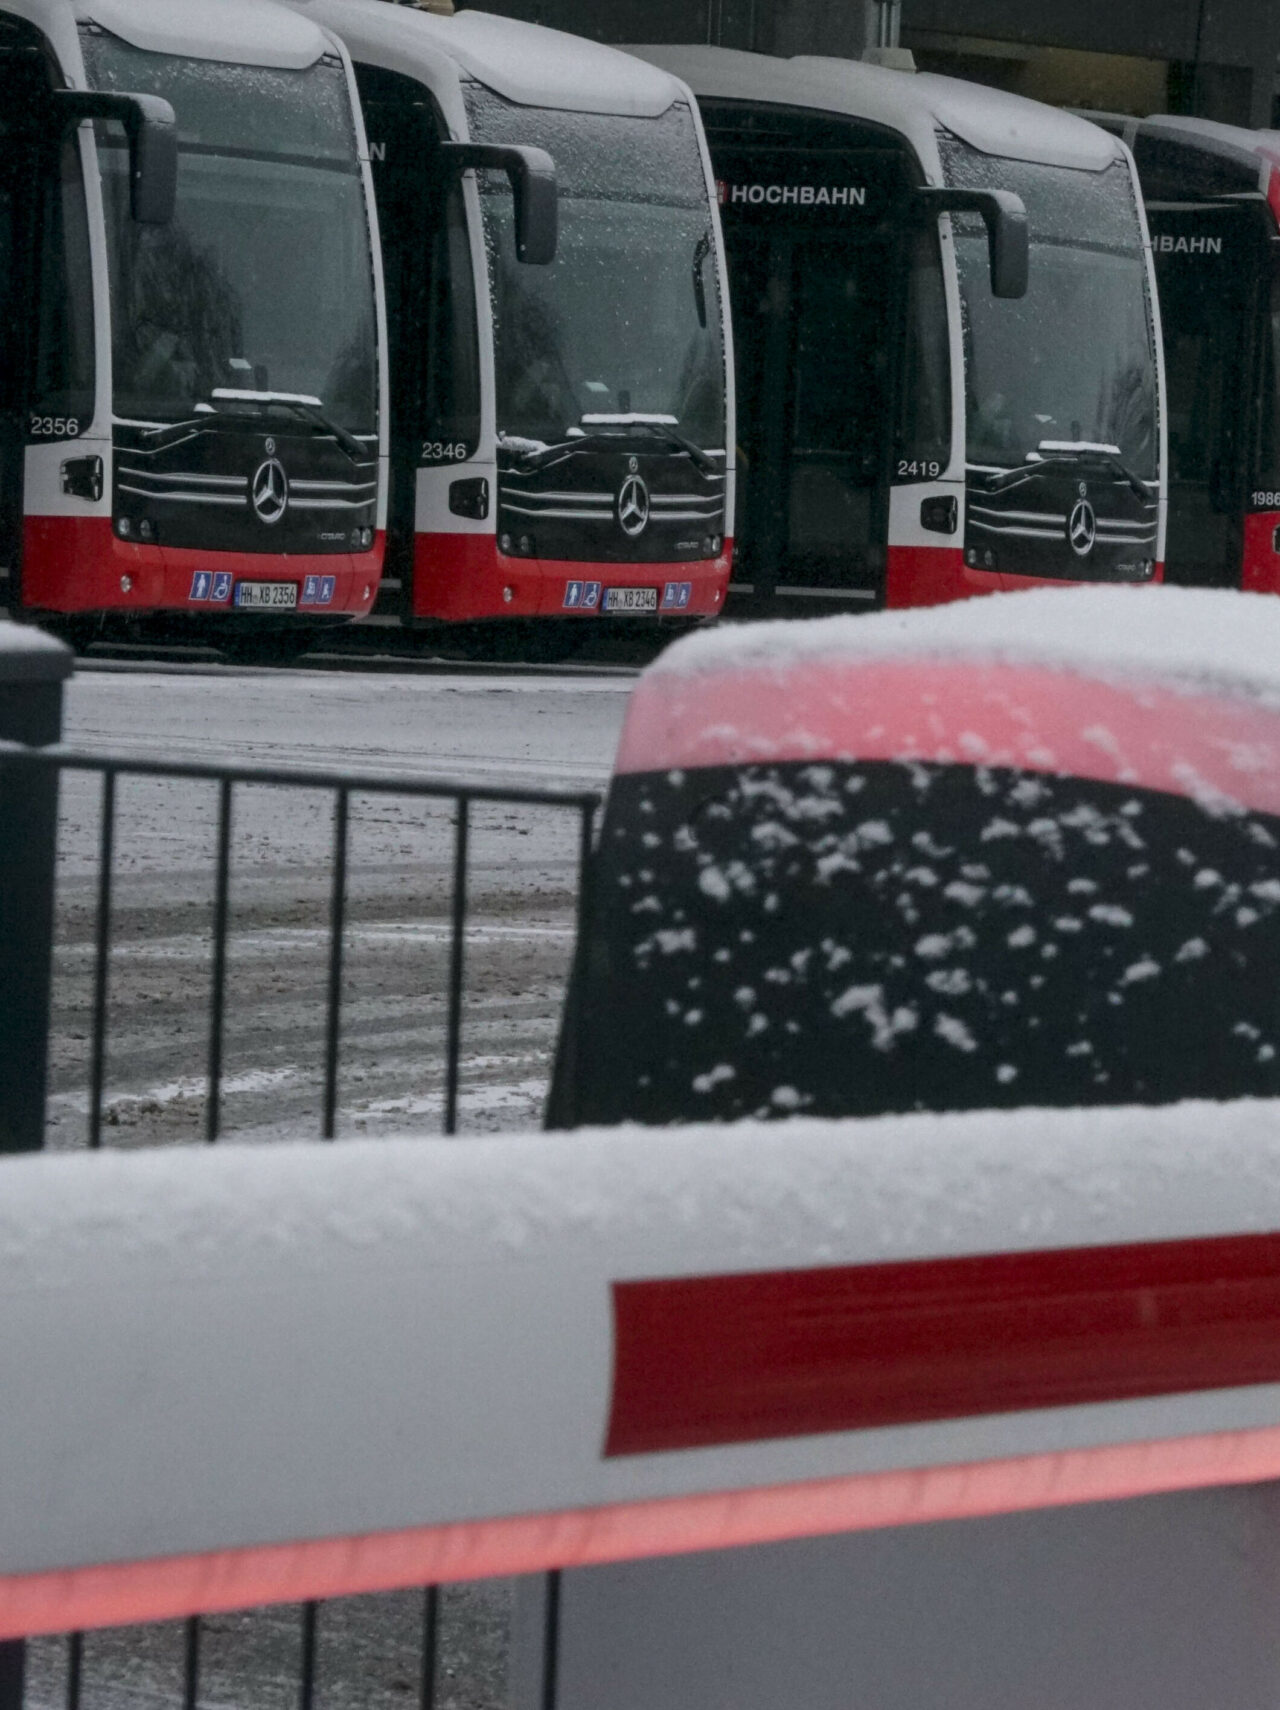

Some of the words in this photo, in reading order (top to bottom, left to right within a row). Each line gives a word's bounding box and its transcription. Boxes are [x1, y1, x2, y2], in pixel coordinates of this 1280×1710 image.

[731, 185, 866, 206] HOCHBAHN
[31, 417, 79, 436] 2356
[422, 442, 467, 459] 2346
[897, 460, 940, 477] 2419
[240, 586, 253, 604] HH
[259, 586, 271, 604] XB
[273, 586, 295, 605] 2356
[624, 591, 634, 607] XB
[635, 591, 656, 607] 2346
